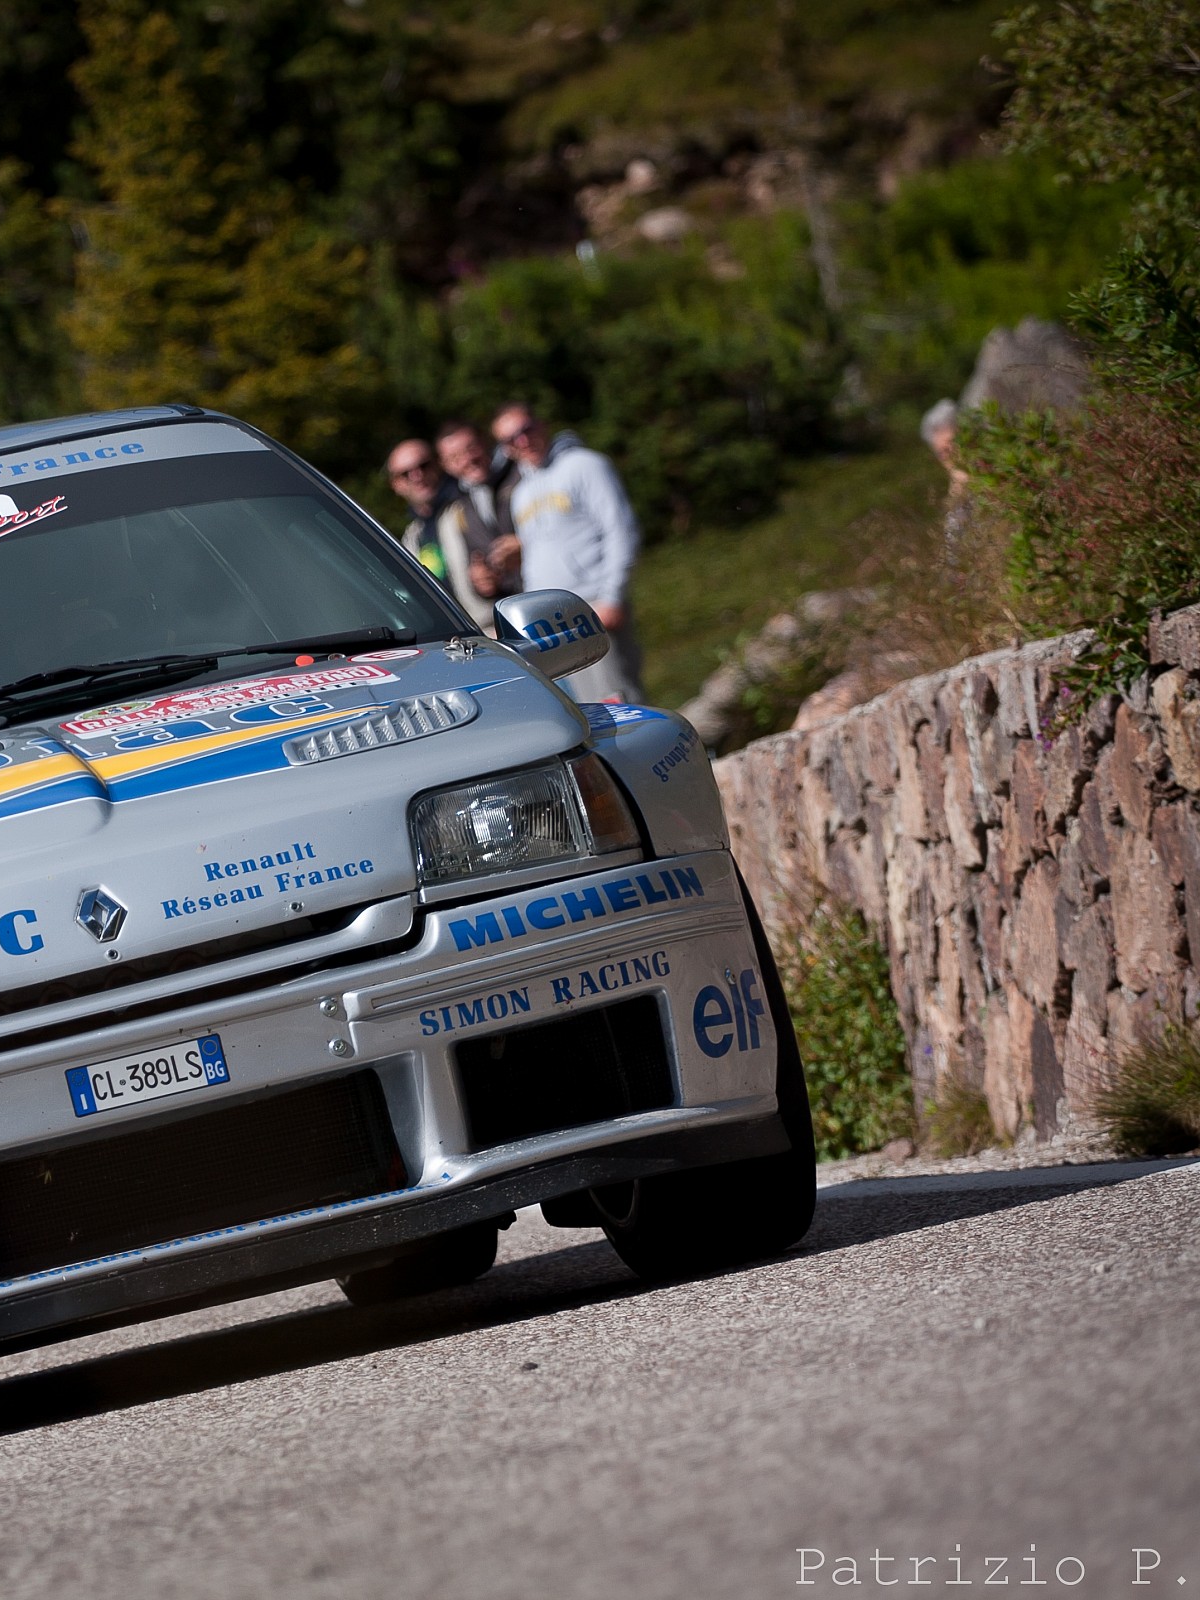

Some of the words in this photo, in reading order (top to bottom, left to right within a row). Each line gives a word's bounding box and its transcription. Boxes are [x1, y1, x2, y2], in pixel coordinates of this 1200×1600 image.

[81, 700, 187, 731] RALLYE
[187, 692, 244, 711] SAN
[250, 665, 366, 697] MARTINO
[652, 740, 691, 783] groupe
[160, 881, 265, 920] Réseau
[274, 856, 375, 893] France
[204, 841, 317, 883] Renault
[448, 866, 705, 953] MICHELIN
[419, 985, 532, 1037] SIMON
[550, 950, 672, 1004] RACING
[693, 968, 765, 1059] elf
[203, 1060, 226, 1081] BG
